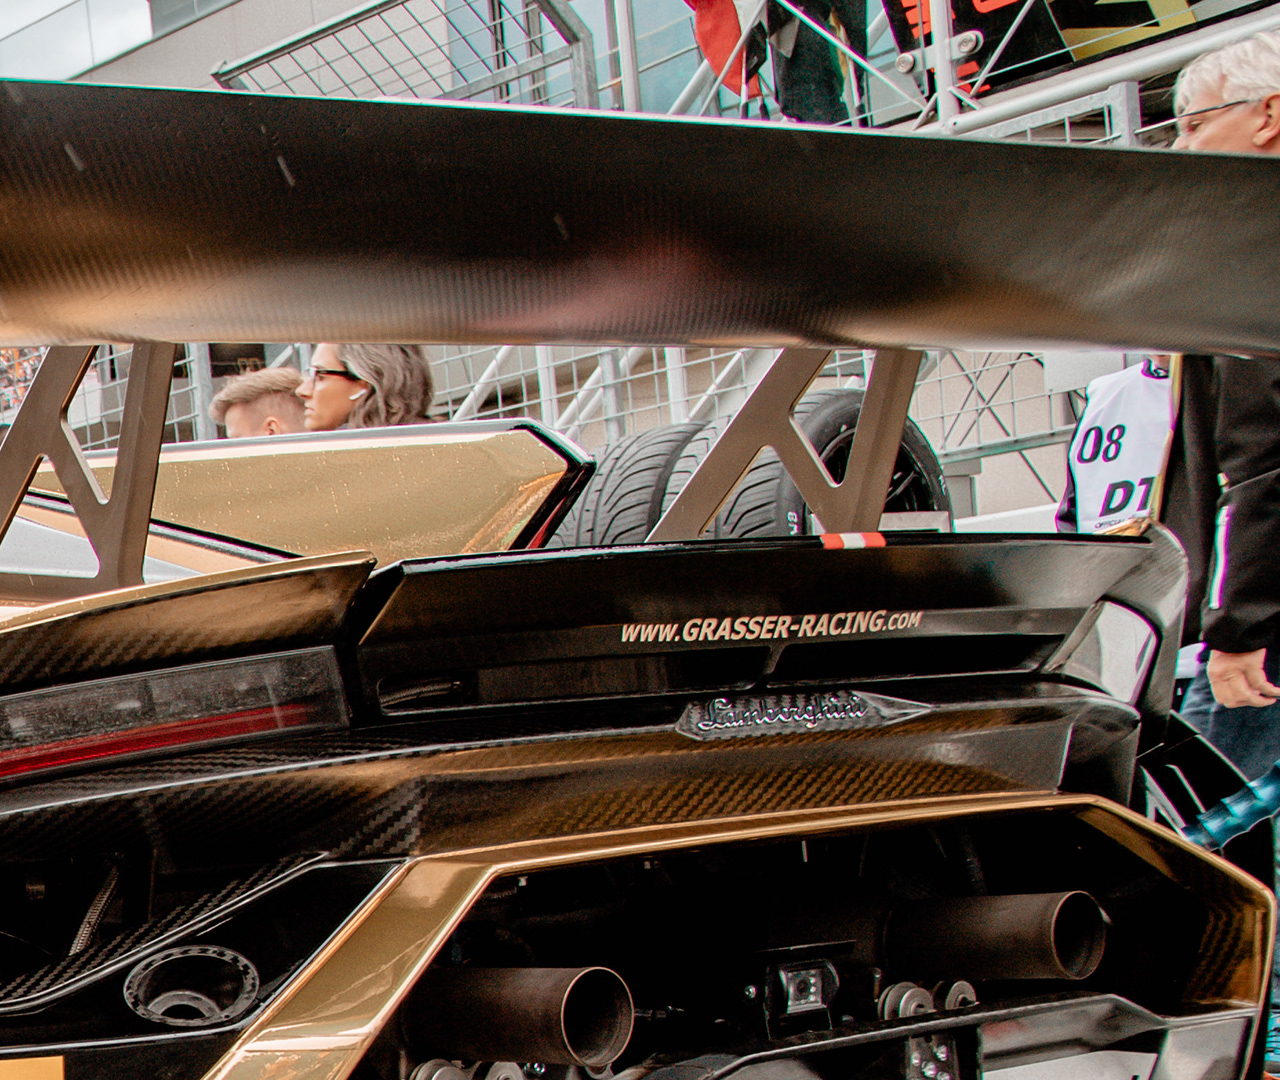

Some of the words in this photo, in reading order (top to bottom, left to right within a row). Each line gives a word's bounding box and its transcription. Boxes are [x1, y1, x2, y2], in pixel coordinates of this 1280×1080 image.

[1077, 424, 1126, 464] 08
[1099, 476, 1157, 517] DT
[697, 697, 869, 729] Lamborghini
